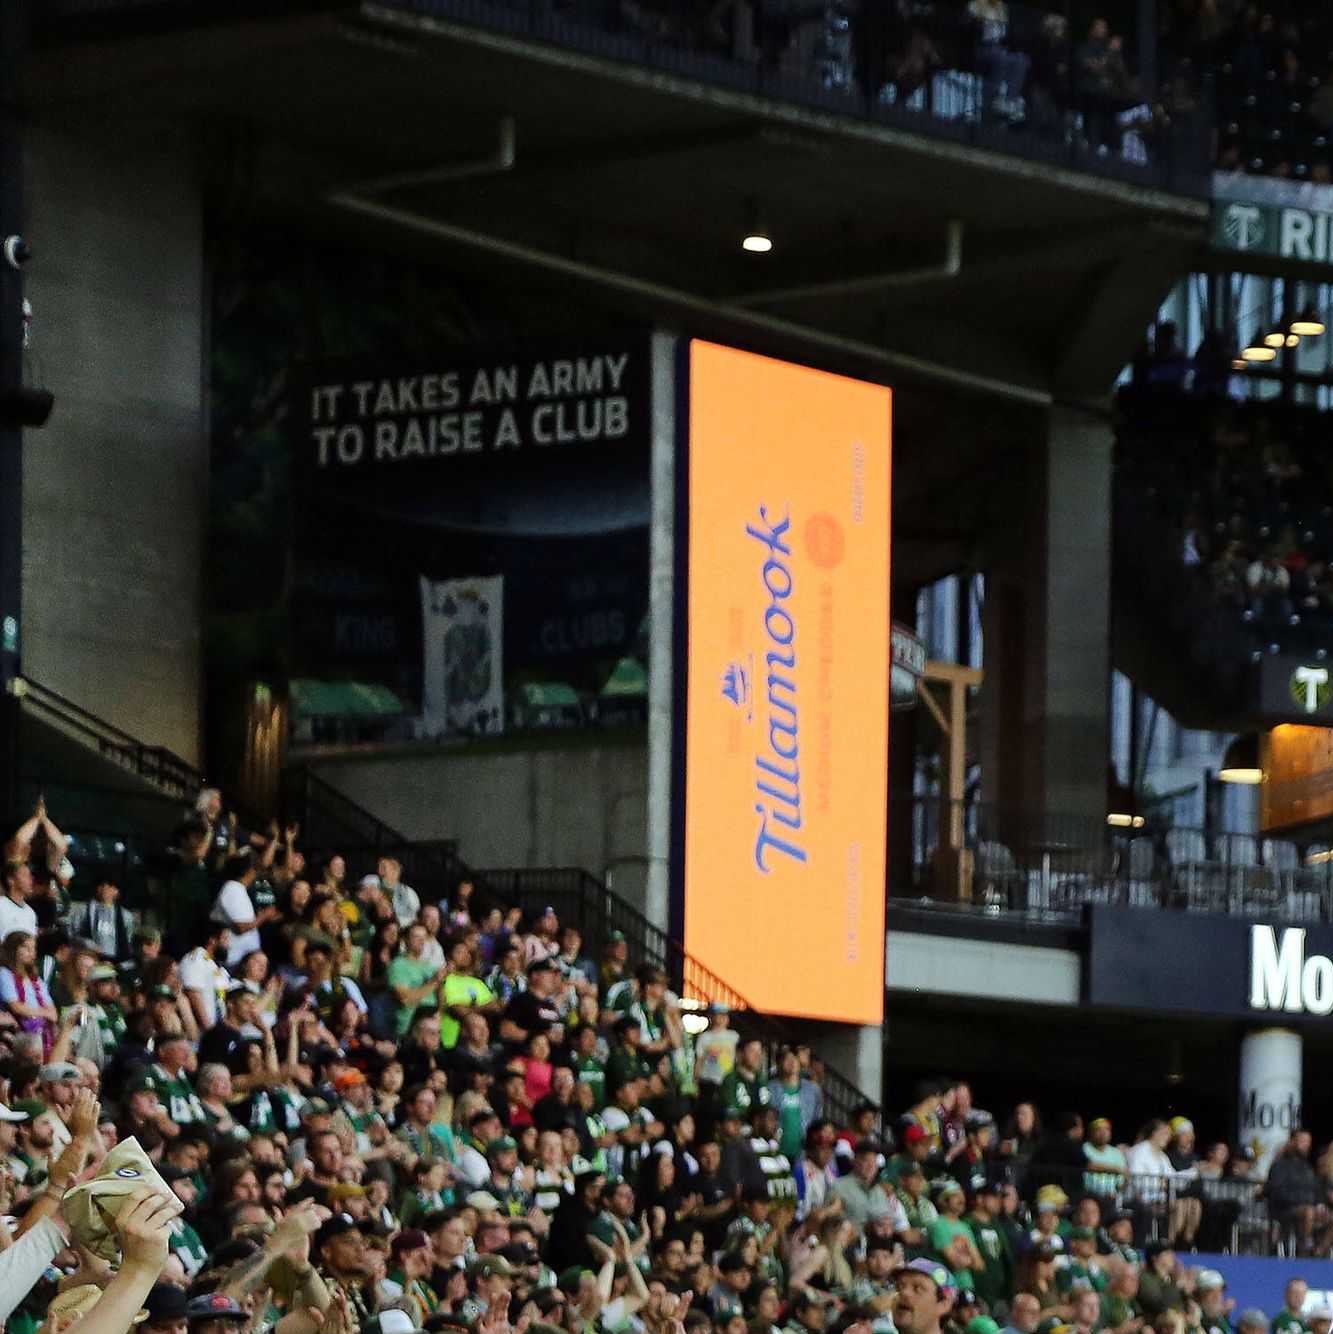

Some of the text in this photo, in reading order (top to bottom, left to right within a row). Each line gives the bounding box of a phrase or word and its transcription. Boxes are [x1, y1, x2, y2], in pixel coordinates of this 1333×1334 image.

[311, 353, 630, 421] IT TAKES AN ARMY
[311, 395, 630, 467] TO RAISE A CLUB
[745, 503, 807, 875] Tillamook
